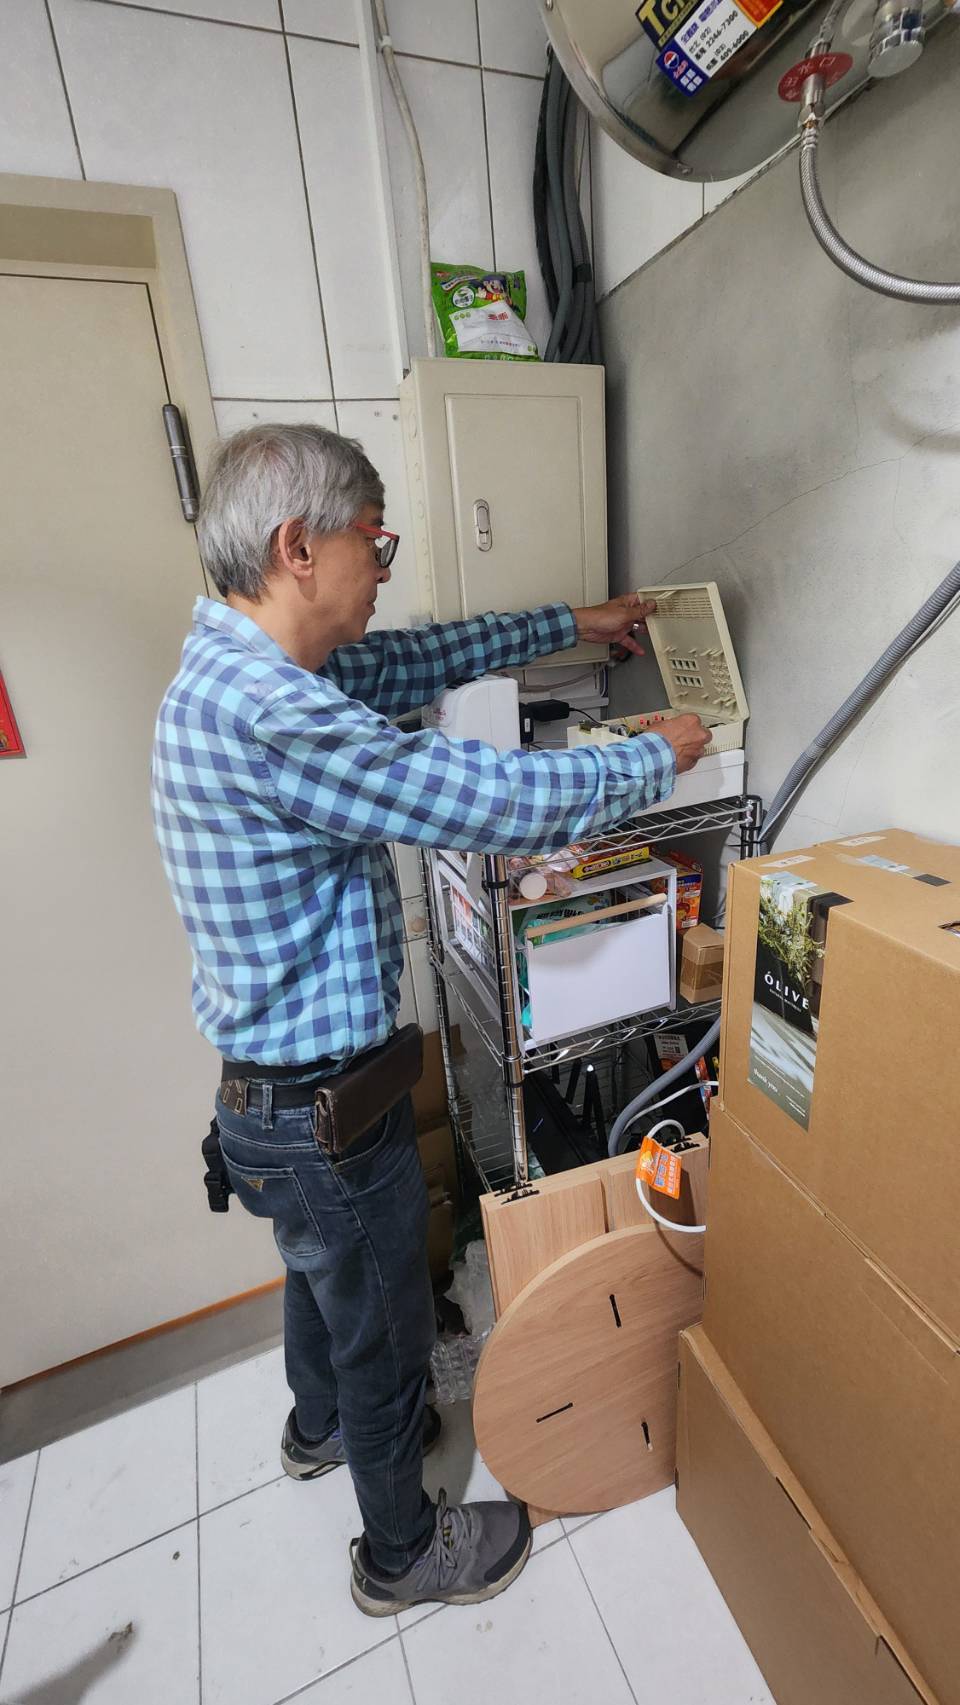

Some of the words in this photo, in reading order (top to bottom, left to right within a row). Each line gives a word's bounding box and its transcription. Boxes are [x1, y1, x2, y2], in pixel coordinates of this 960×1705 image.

[706, 10, 739, 48] 2246-7300
[720, 30, 749, 62] 409-6000
[764, 971, 809, 1010] ÓLIVE
